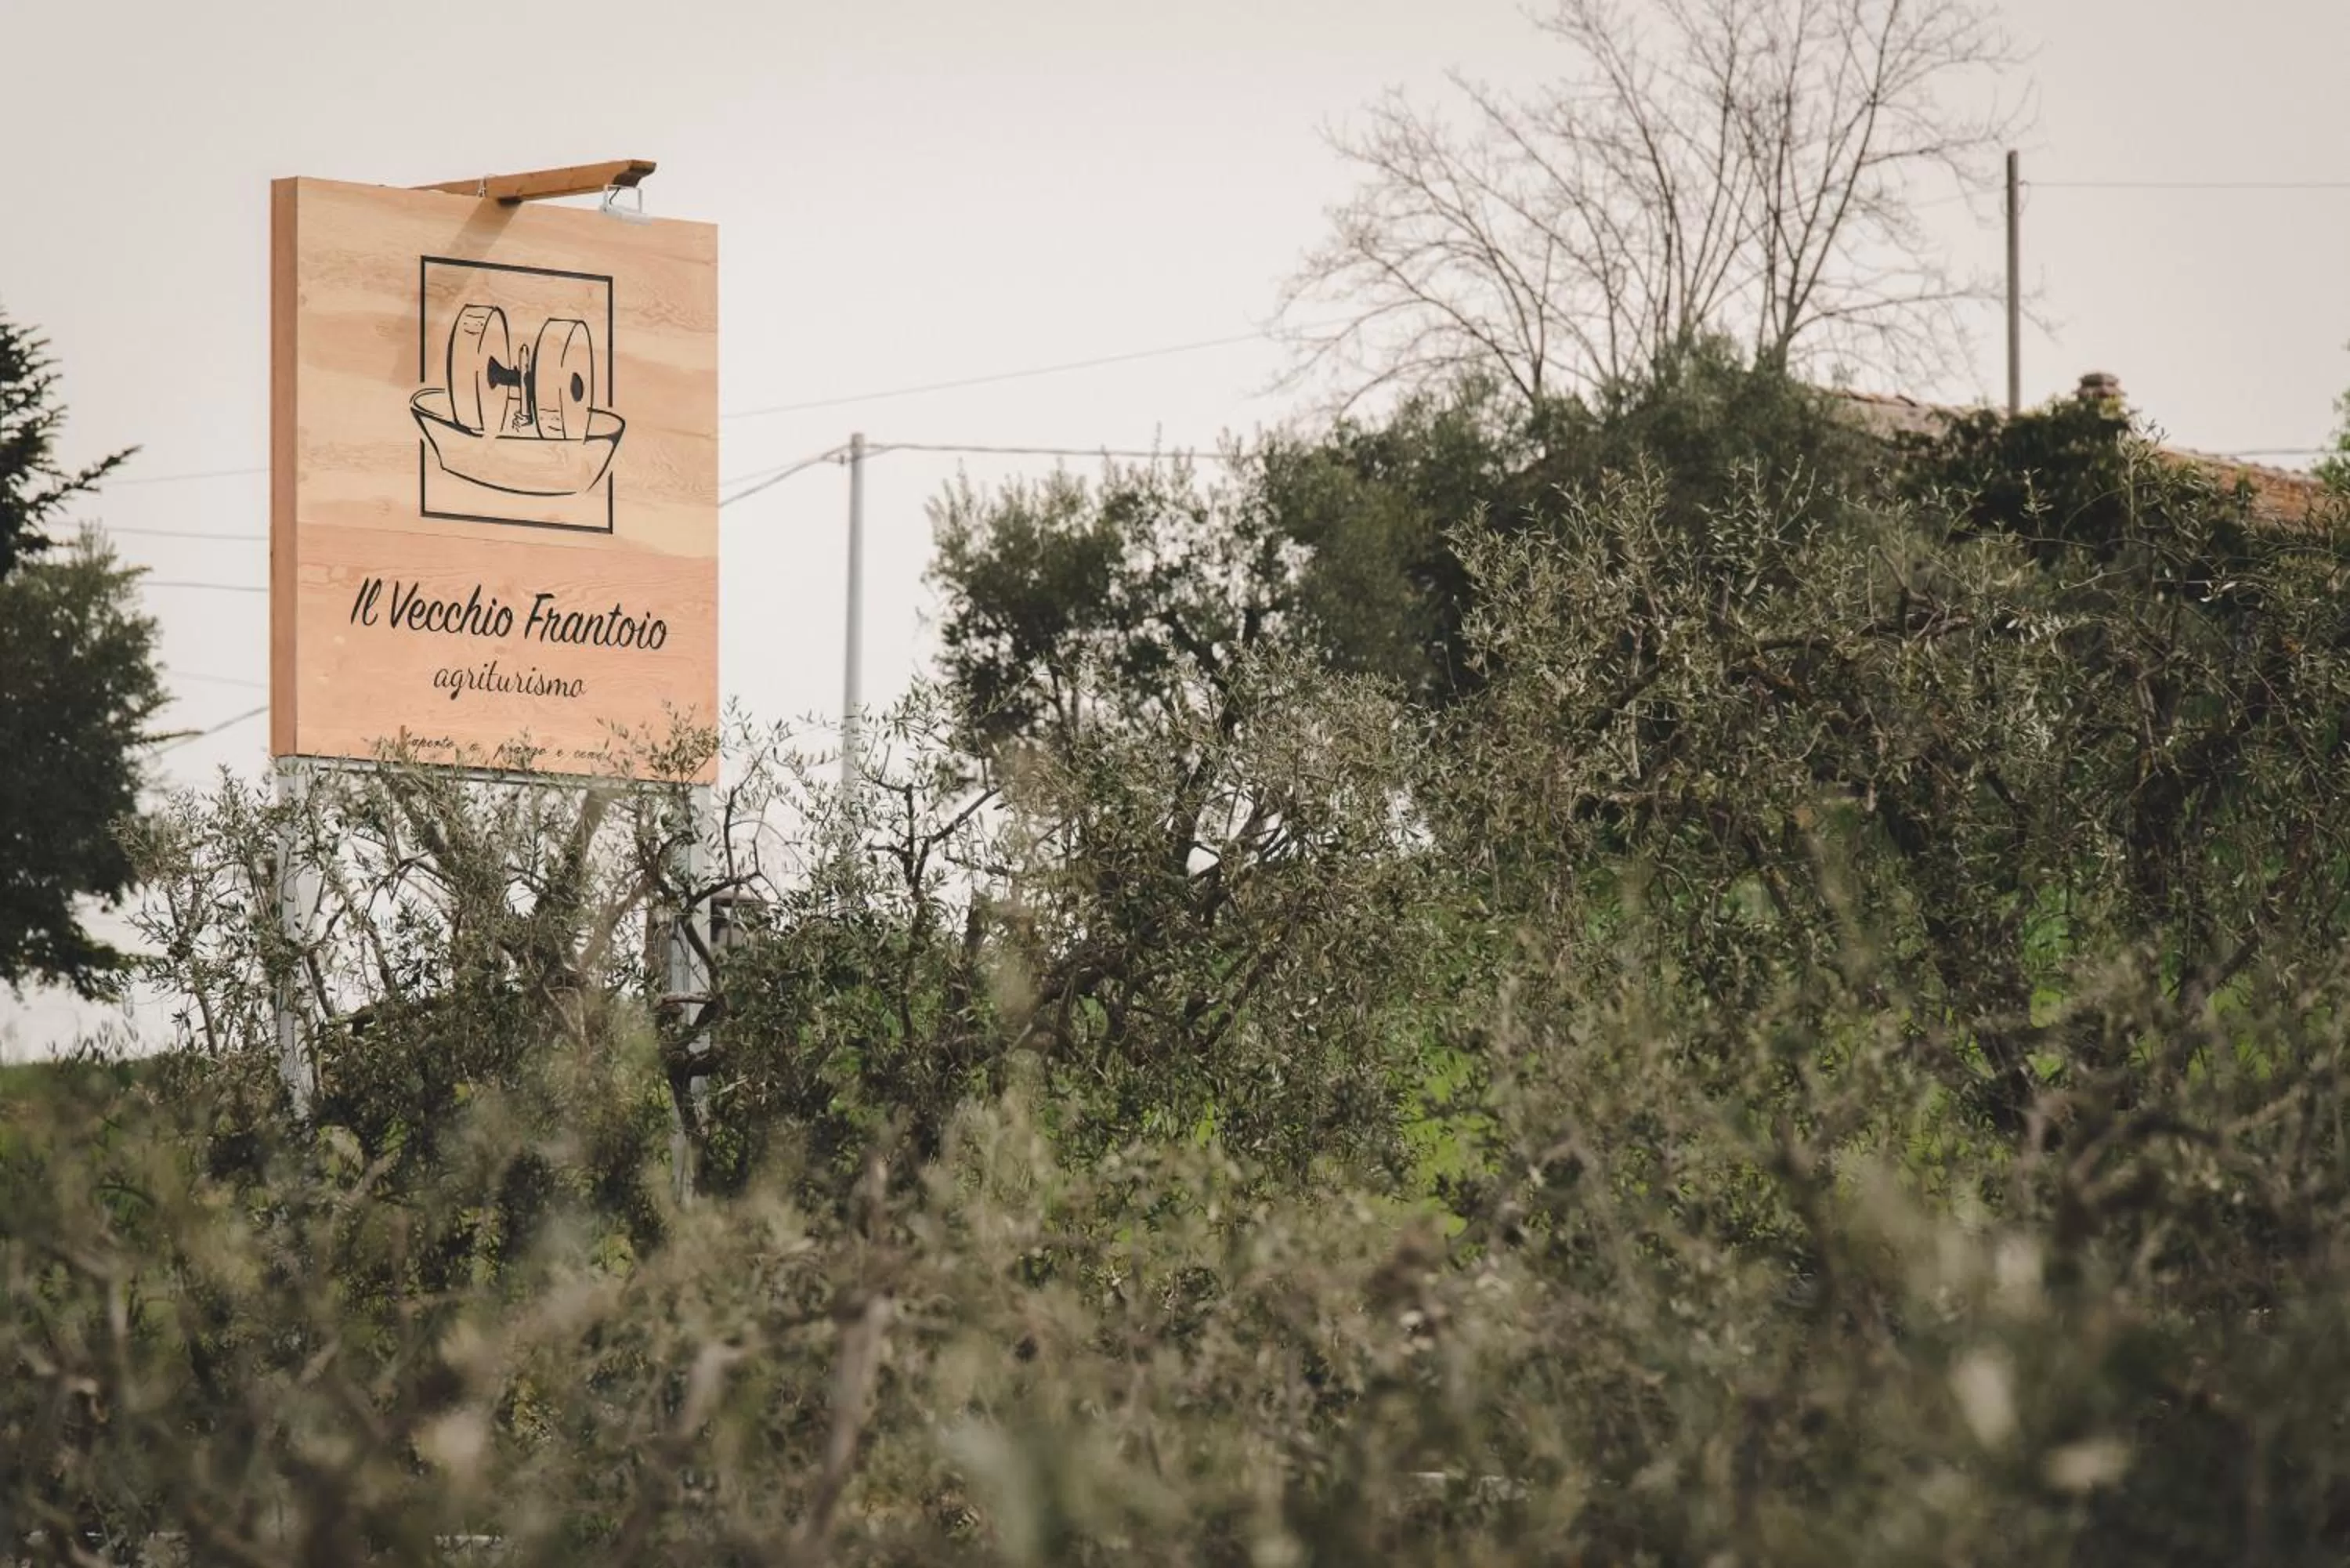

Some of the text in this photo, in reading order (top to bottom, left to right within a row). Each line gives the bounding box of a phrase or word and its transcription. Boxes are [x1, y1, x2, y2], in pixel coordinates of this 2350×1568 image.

[350, 576, 667, 650] Il Vecchio Frantoio
[433, 660, 586, 700] agriturismo
